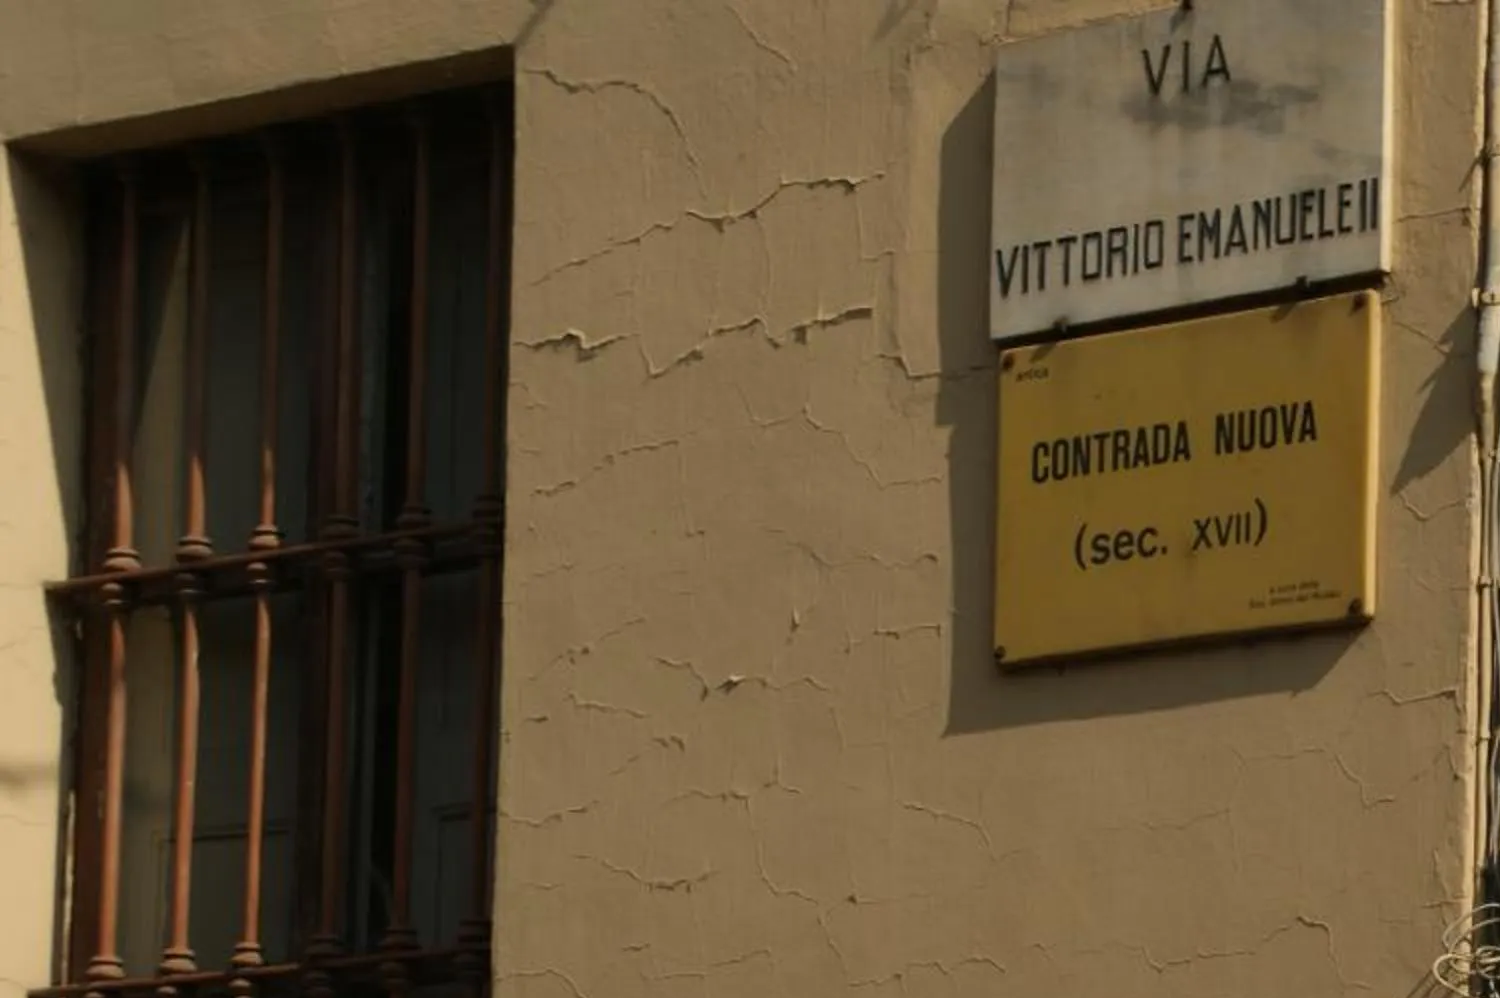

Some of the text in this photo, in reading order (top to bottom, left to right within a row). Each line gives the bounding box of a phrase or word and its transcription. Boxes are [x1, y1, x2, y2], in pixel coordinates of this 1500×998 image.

[1141, 35, 1231, 97] VIA
[995, 219, 1165, 299] VITTORIO
[1177, 183, 1353, 264] EMANUELE
[1031, 401, 1318, 484] CONTRADA NUOVA
[1074, 498, 1268, 570] (sec. XVII)
